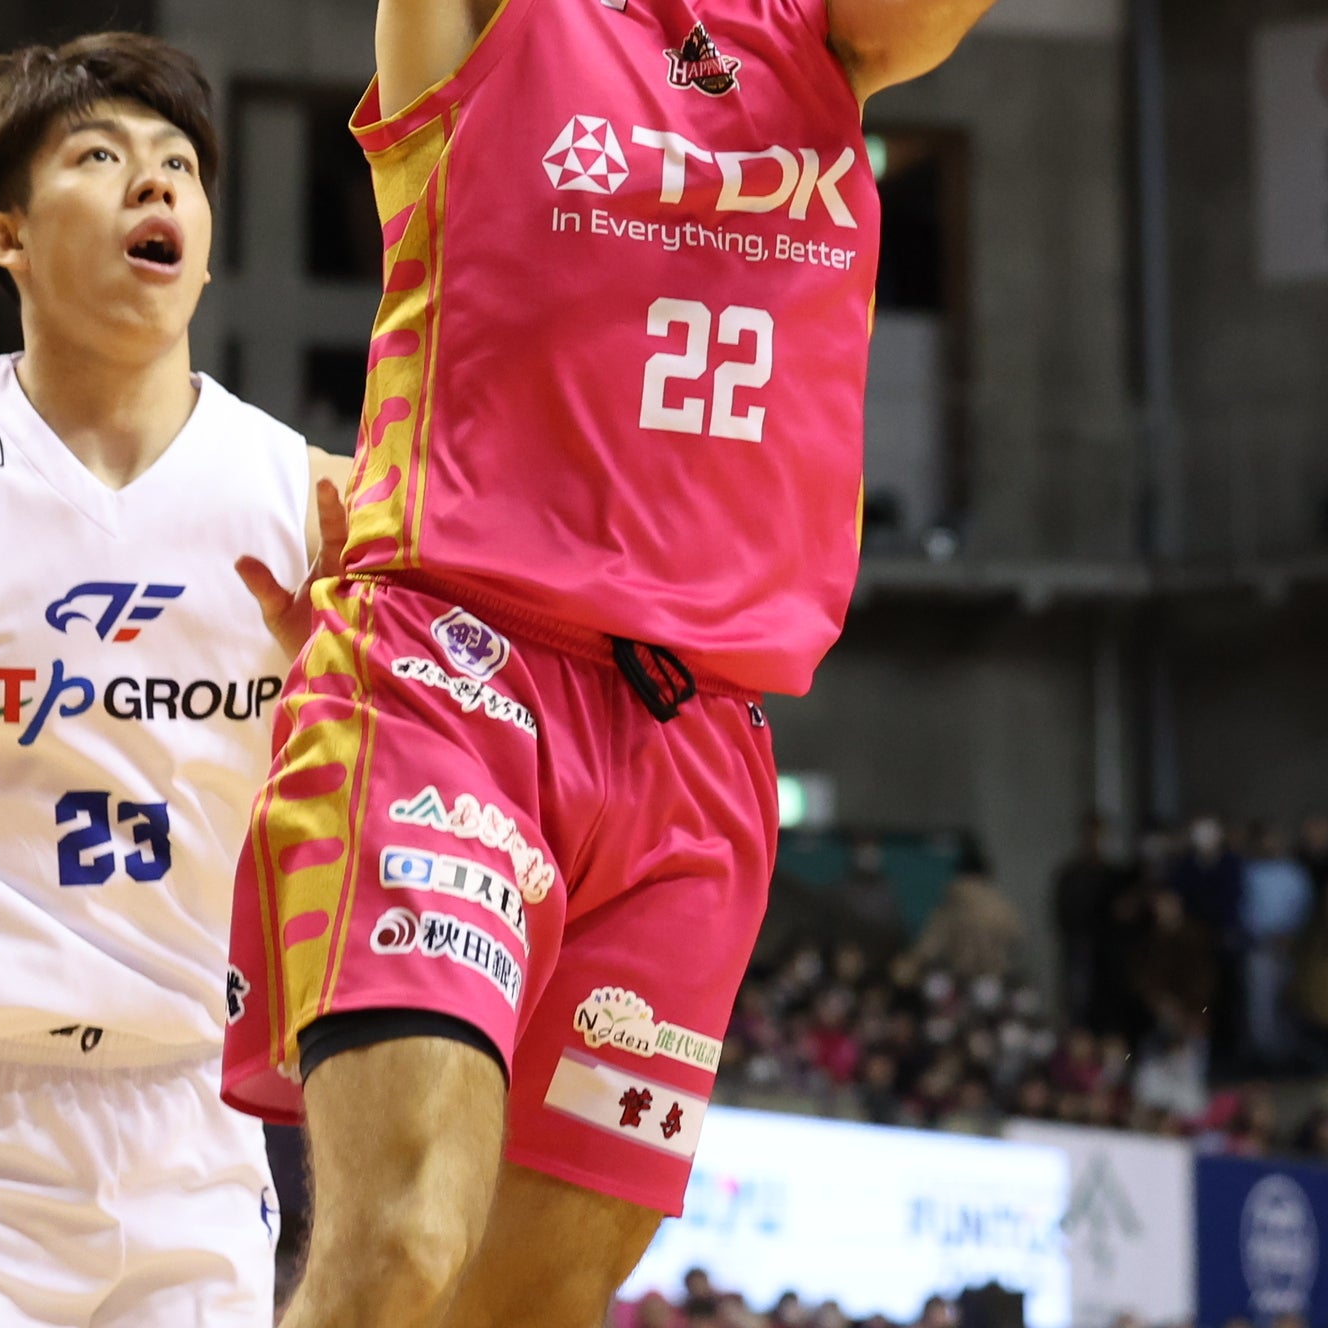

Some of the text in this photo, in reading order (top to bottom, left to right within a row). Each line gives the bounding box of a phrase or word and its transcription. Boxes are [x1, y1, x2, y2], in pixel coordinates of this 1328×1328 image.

[631, 124, 858, 230] TDK
[552, 207, 857, 272] In Everything, Better
[638, 296, 775, 444] 22
[103, 675, 283, 721] GROUP
[55, 790, 172, 886] 23
